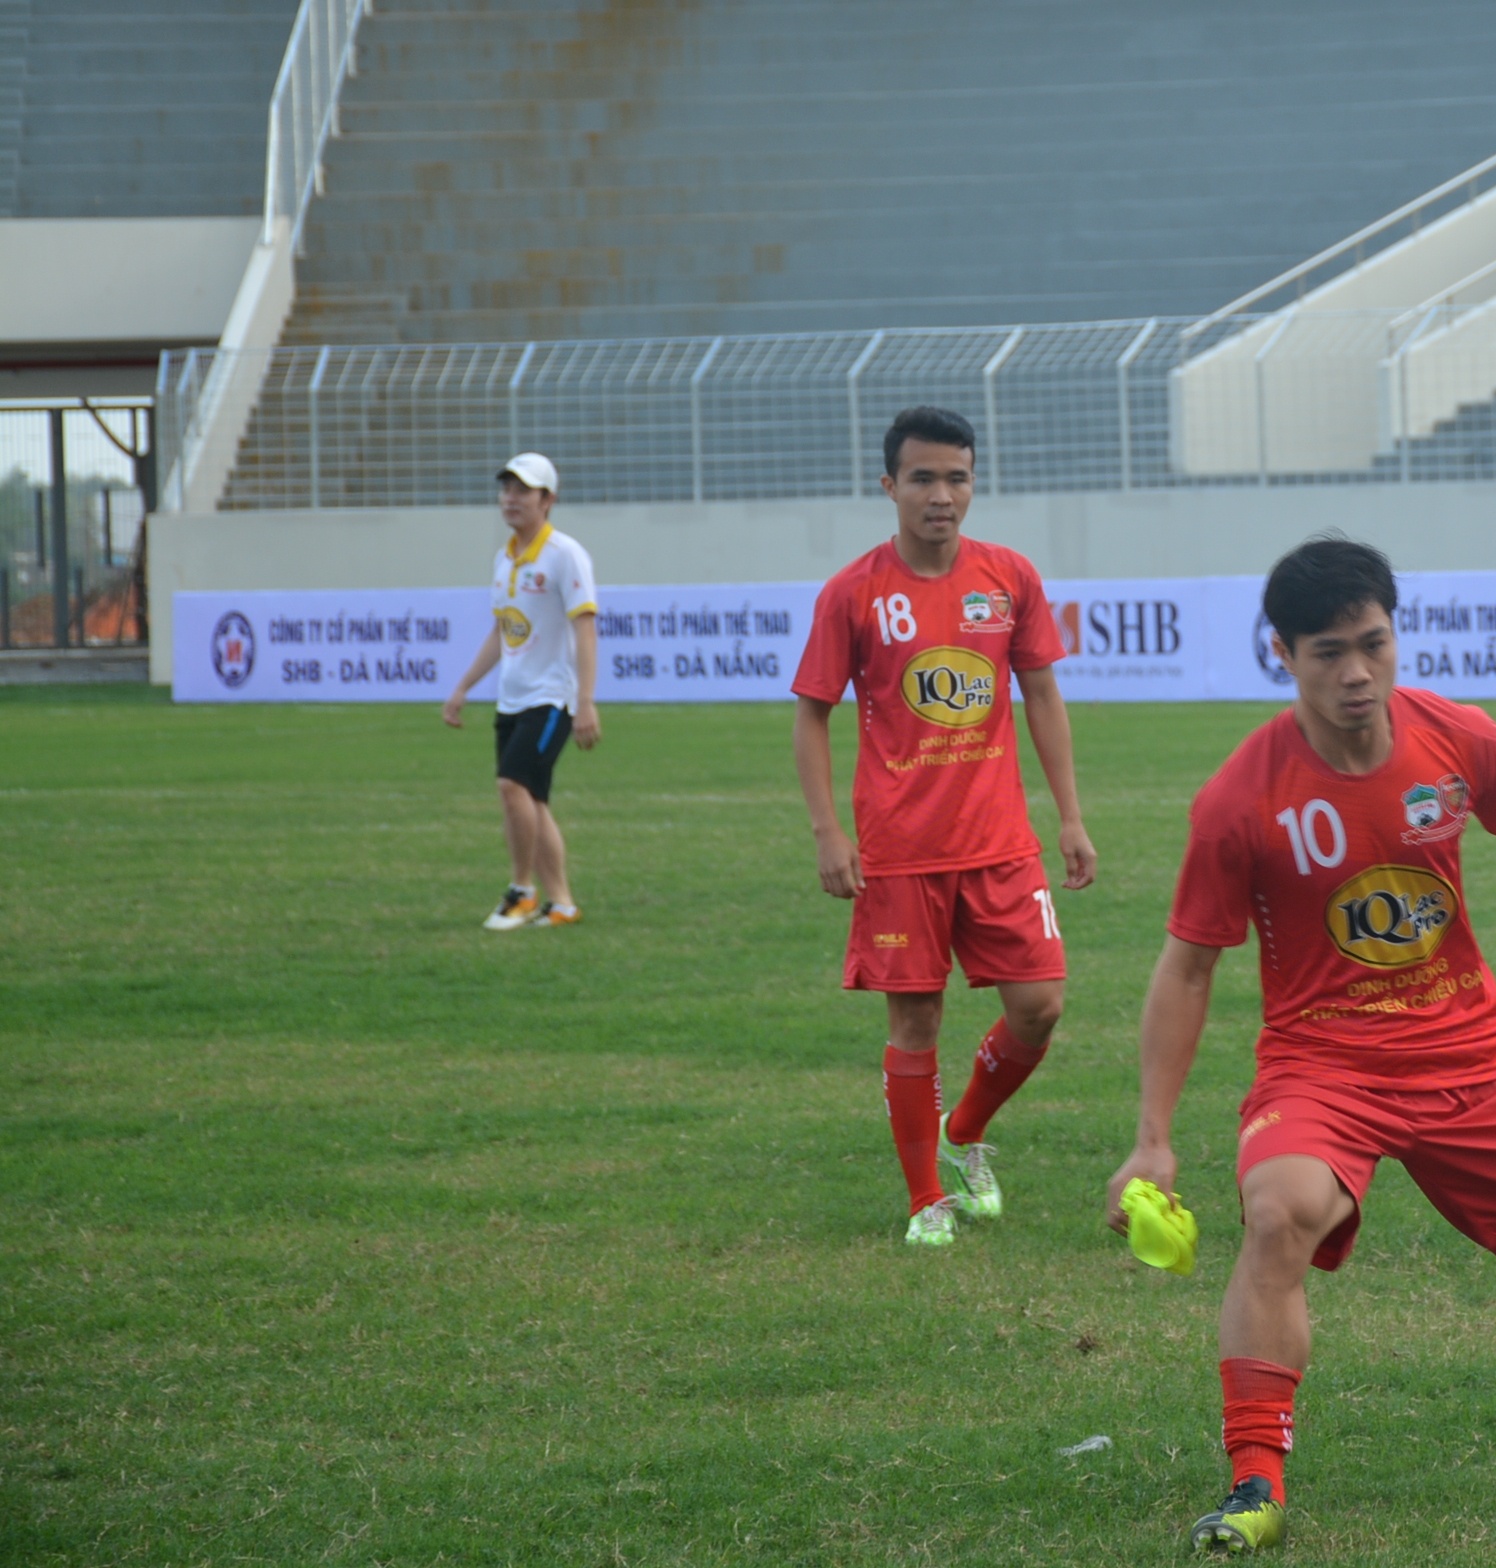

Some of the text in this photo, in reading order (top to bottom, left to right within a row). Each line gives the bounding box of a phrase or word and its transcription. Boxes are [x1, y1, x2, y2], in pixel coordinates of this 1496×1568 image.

[308, 618, 323, 643] TY
[639, 612, 653, 637] TY
[872, 592, 917, 646] 18
[1088, 600, 1181, 656] SHB
[282, 658, 322, 683] SHB
[613, 654, 656, 678] SHB
[912, 666, 993, 711] IQ Lac
[964, 692, 992, 710] Pro
[1276, 798, 1347, 876] 10
[1338, 891, 1444, 945] IQ Lac
[1411, 909, 1450, 938] Pro
[1459, 969, 1485, 990] CA
